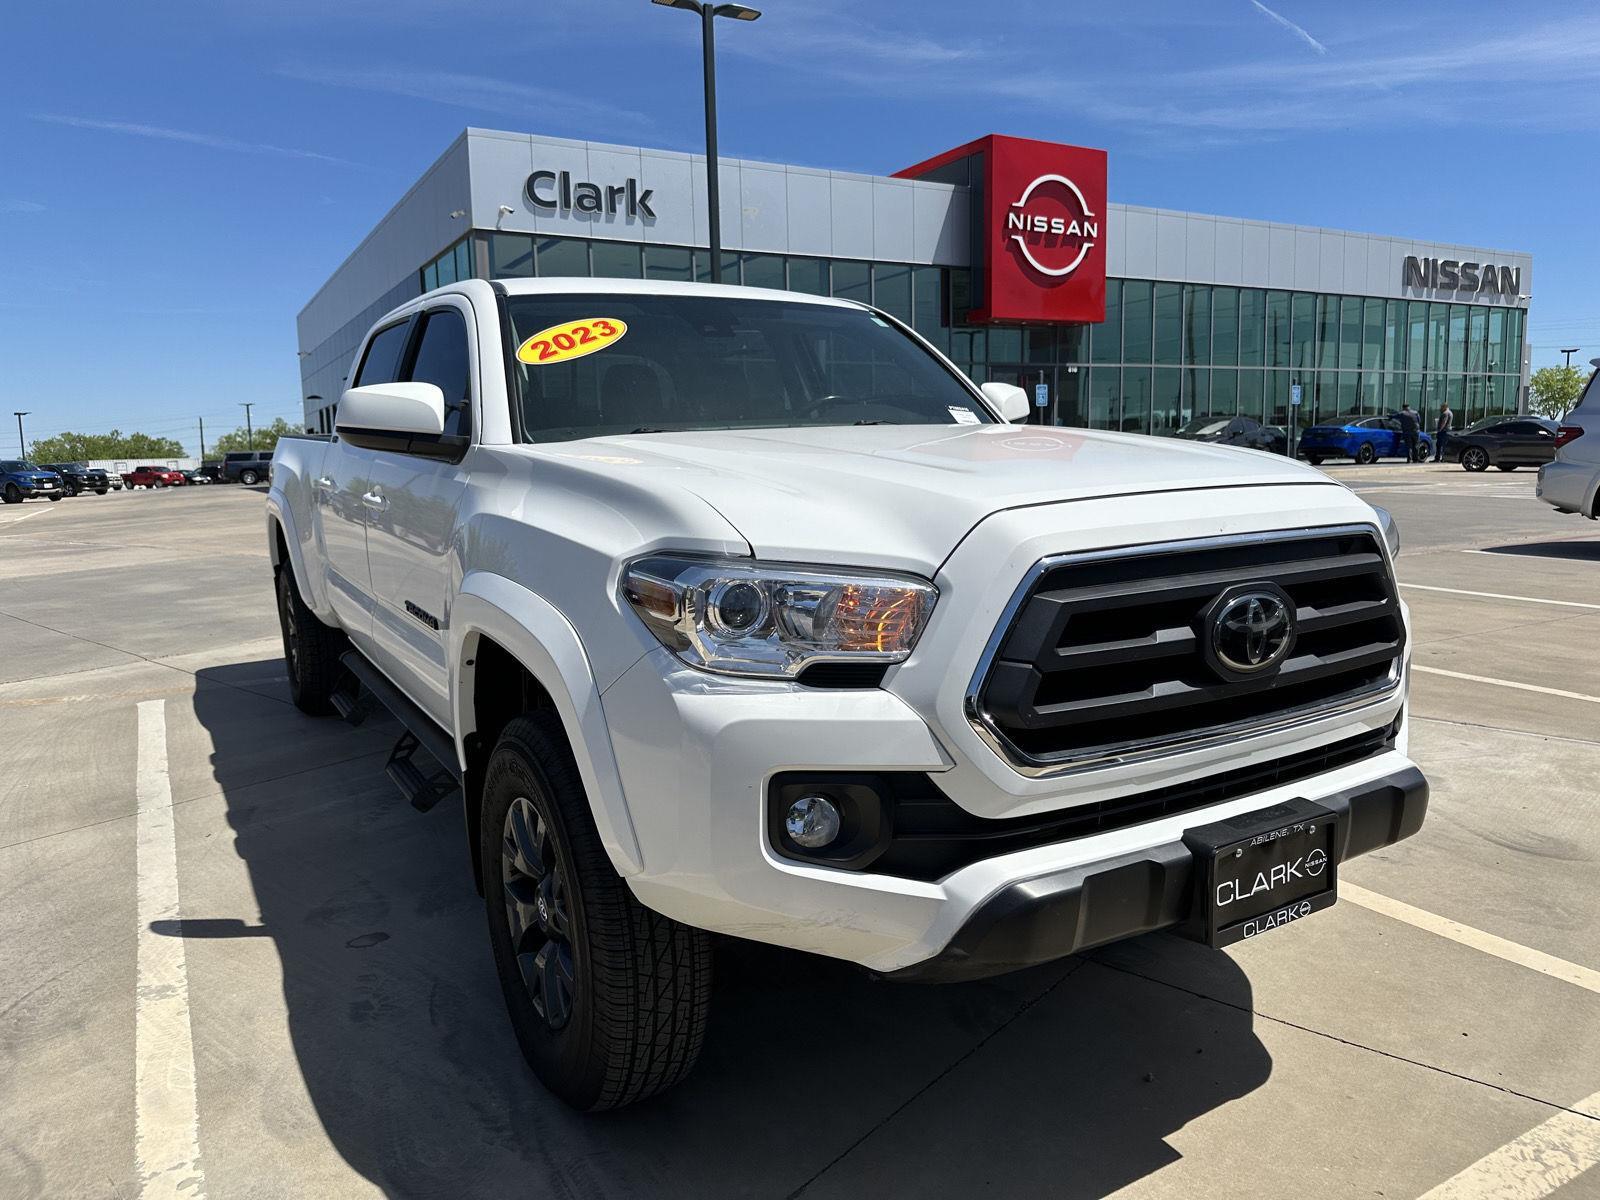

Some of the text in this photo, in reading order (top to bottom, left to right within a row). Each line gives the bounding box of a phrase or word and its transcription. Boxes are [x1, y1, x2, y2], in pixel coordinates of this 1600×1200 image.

[525, 170, 657, 218] Clark
[1008, 212, 1098, 238] NISSAN
[1405, 256, 1521, 295] NISSAN
[530, 320, 617, 361] 2023
[1293, 823, 1305, 833] TX
[1216, 857, 1303, 907] CLARK
[1243, 905, 1299, 939] CLARK
